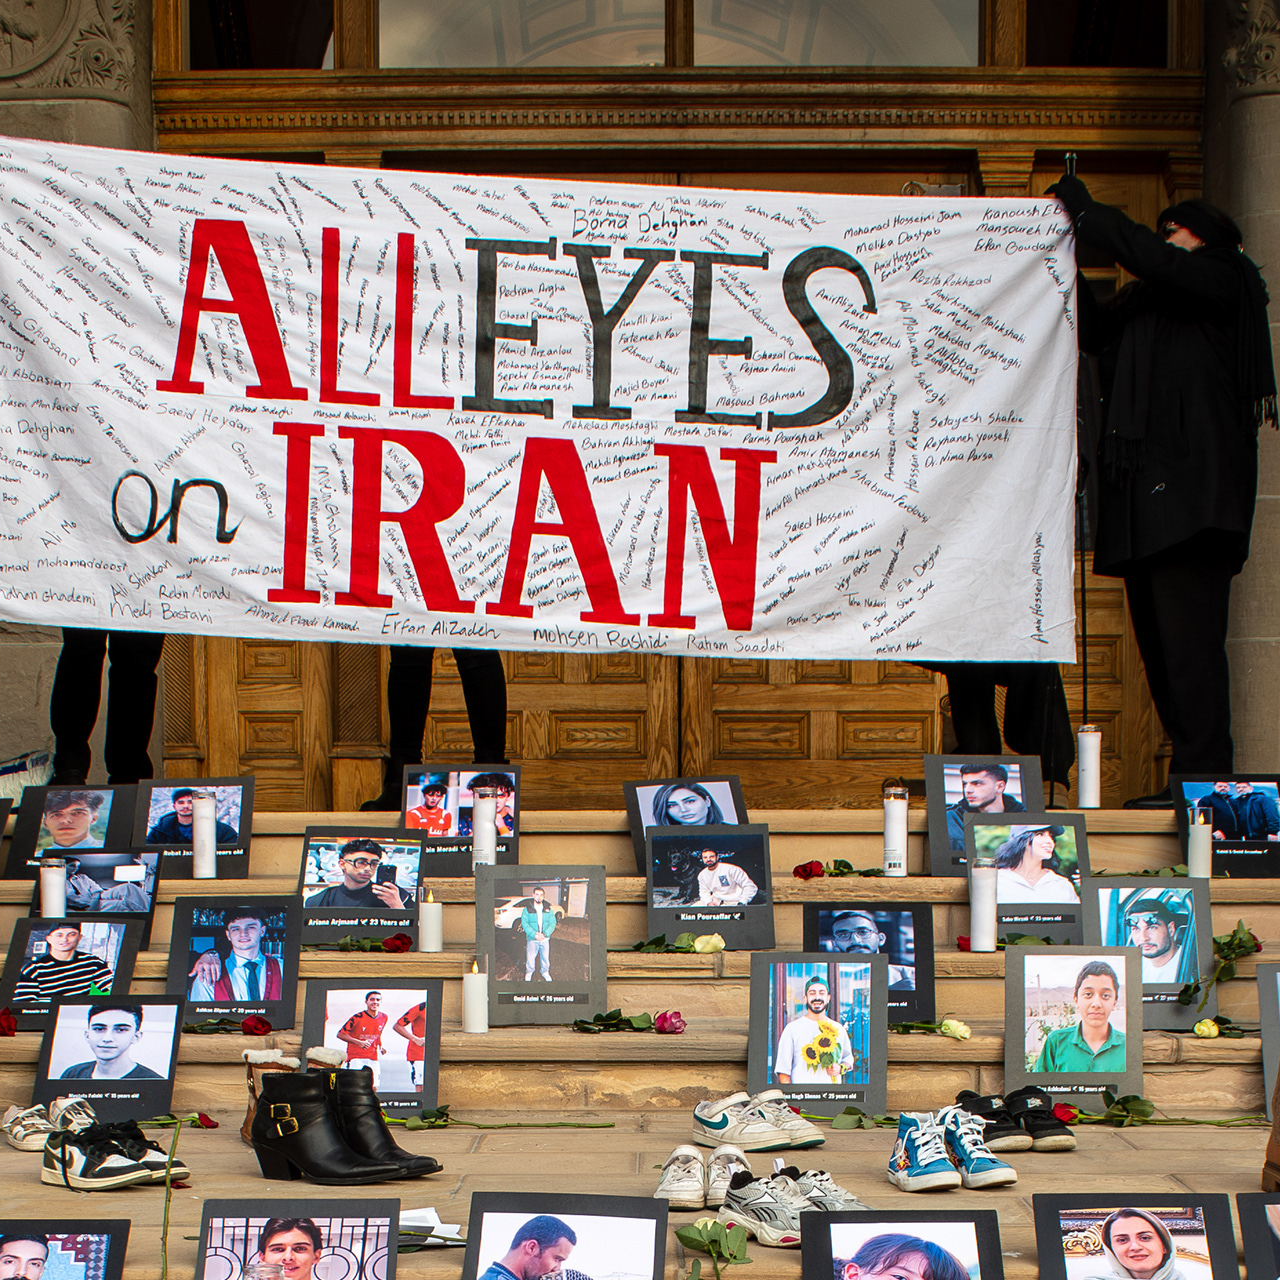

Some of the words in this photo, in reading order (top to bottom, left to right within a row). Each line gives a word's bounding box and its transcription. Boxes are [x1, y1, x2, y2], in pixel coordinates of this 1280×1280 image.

[572, 208, 628, 239] Borna
[638, 211, 708, 239] Dehghani
[156, 218, 455, 408] ALL
[462, 236, 877, 432] EYES
[13, 368, 72, 391] Abbasian
[111, 469, 246, 544] on
[267, 421, 777, 632] IRAN
[381, 612, 426, 636] Erfan
[431, 620, 500, 639] AliZadeh
[606, 628, 670, 650] Rashidi
